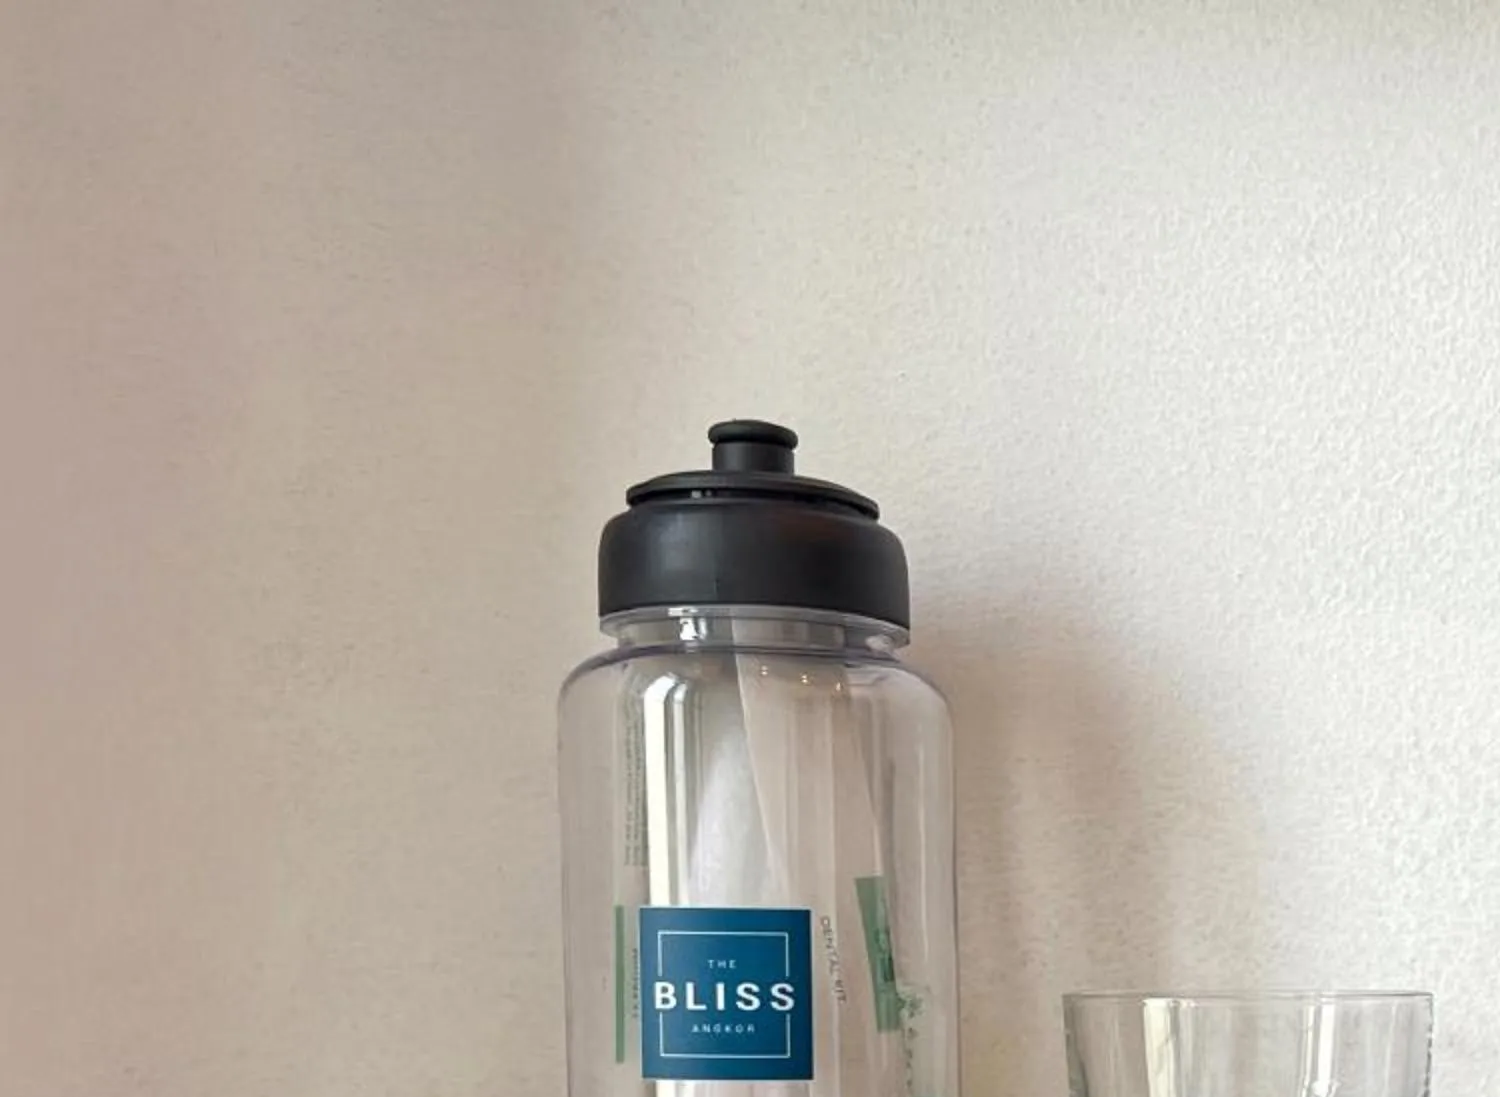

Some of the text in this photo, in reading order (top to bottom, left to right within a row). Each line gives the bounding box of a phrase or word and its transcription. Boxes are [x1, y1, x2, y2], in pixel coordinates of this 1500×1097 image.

[707, 959, 737, 969] THE
[654, 981, 795, 1011] BLISS
[691, 1024, 755, 1033] ANGKOR
